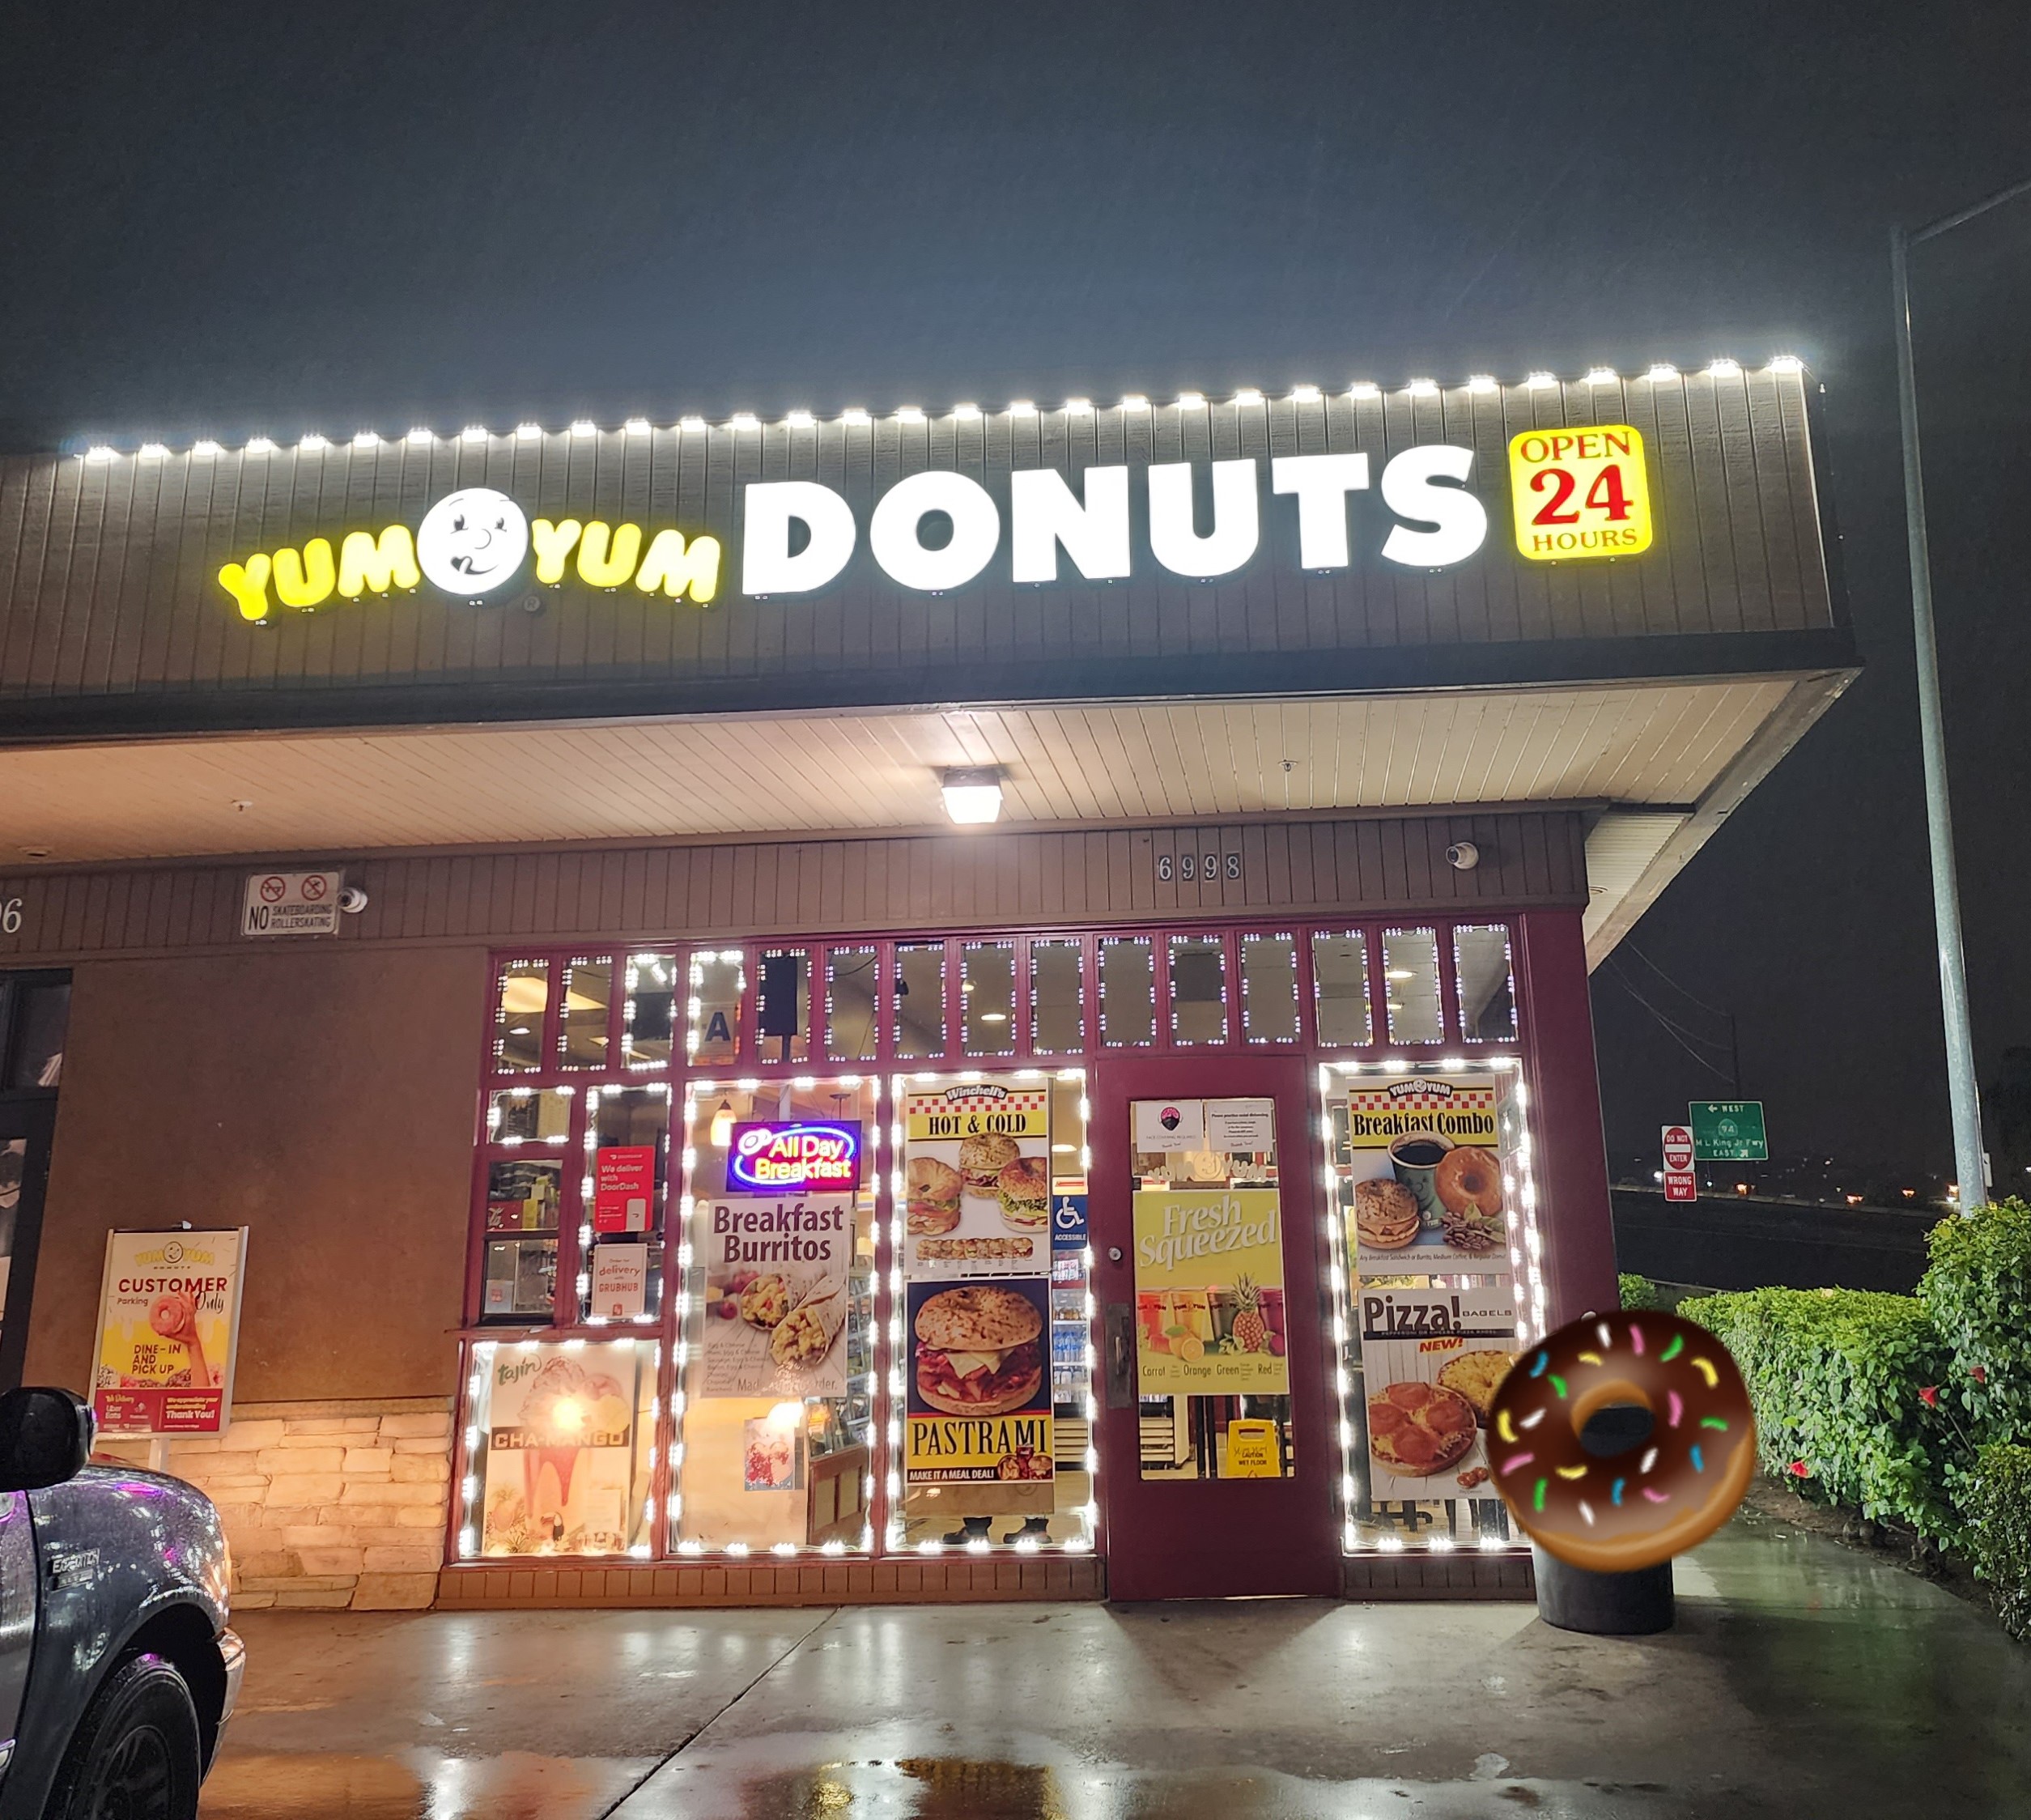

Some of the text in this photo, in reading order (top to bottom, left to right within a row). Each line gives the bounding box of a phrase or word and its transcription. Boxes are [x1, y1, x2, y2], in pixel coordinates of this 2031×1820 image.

[1520, 431, 1630, 463] OPEN
[1530, 464, 1634, 525] 24
[219, 444, 1486, 620] YUM YUM DONUTS
[1532, 528, 1638, 551] HOURS
[1159, 856, 1239, 880] 6998
[0, 897, 23, 933] 6
[249, 904, 333, 930] NO SKATEBOARDING
[705, 1011, 731, 1042] A
[946, 1086, 1006, 1100] Winchell's
[1390, 1082, 1451, 1096] YUM YUM
[928, 1113, 1026, 1135] HOT & COLD
[1353, 1112, 1494, 1136] Breakfast Combo
[769, 1135, 844, 1159] All Day
[1713, 1138, 1731, 1148] King
[1669, 1155, 1688, 1163] ENTER
[754, 1157, 852, 1180] Breakfast
[601, 1182, 639, 1191] DoorDash
[1668, 1176, 1692, 1184] WRONG
[1672, 1188, 1688, 1197] WAY
[714, 1203, 843, 1234] Breakfast
[1163, 1194, 1242, 1238] Fresh
[1055, 1233, 1086, 1241] ACCESSIBLE
[1139, 1209, 1277, 1272] Squeezed
[724, 1232, 831, 1264] Burritos
[599, 1265, 641, 1277] delivery
[118, 1277, 227, 1293] CUSTOMER
[599, 1282, 639, 1293] GRUBHUB
[117, 1297, 149, 1307] Parking
[1364, 1295, 1461, 1333] Pizza!
[1419, 1337, 1464, 1353] NEW!
[132, 1354, 156, 1364] AND
[131, 1364, 174, 1375] PICK UP
[1143, 1365, 1166, 1376] Carrot
[1183, 1364, 1212, 1378] Orange
[1217, 1364, 1239, 1376] Green
[1258, 1363, 1273, 1375] Red
[737, 1379, 766, 1393] Mad
[165, 1410, 215, 1419] Thank You!
[912, 1419, 1047, 1456] PASTRAMI
[909, 1469, 994, 1481] MAKE IT A MEAL DEAL!
